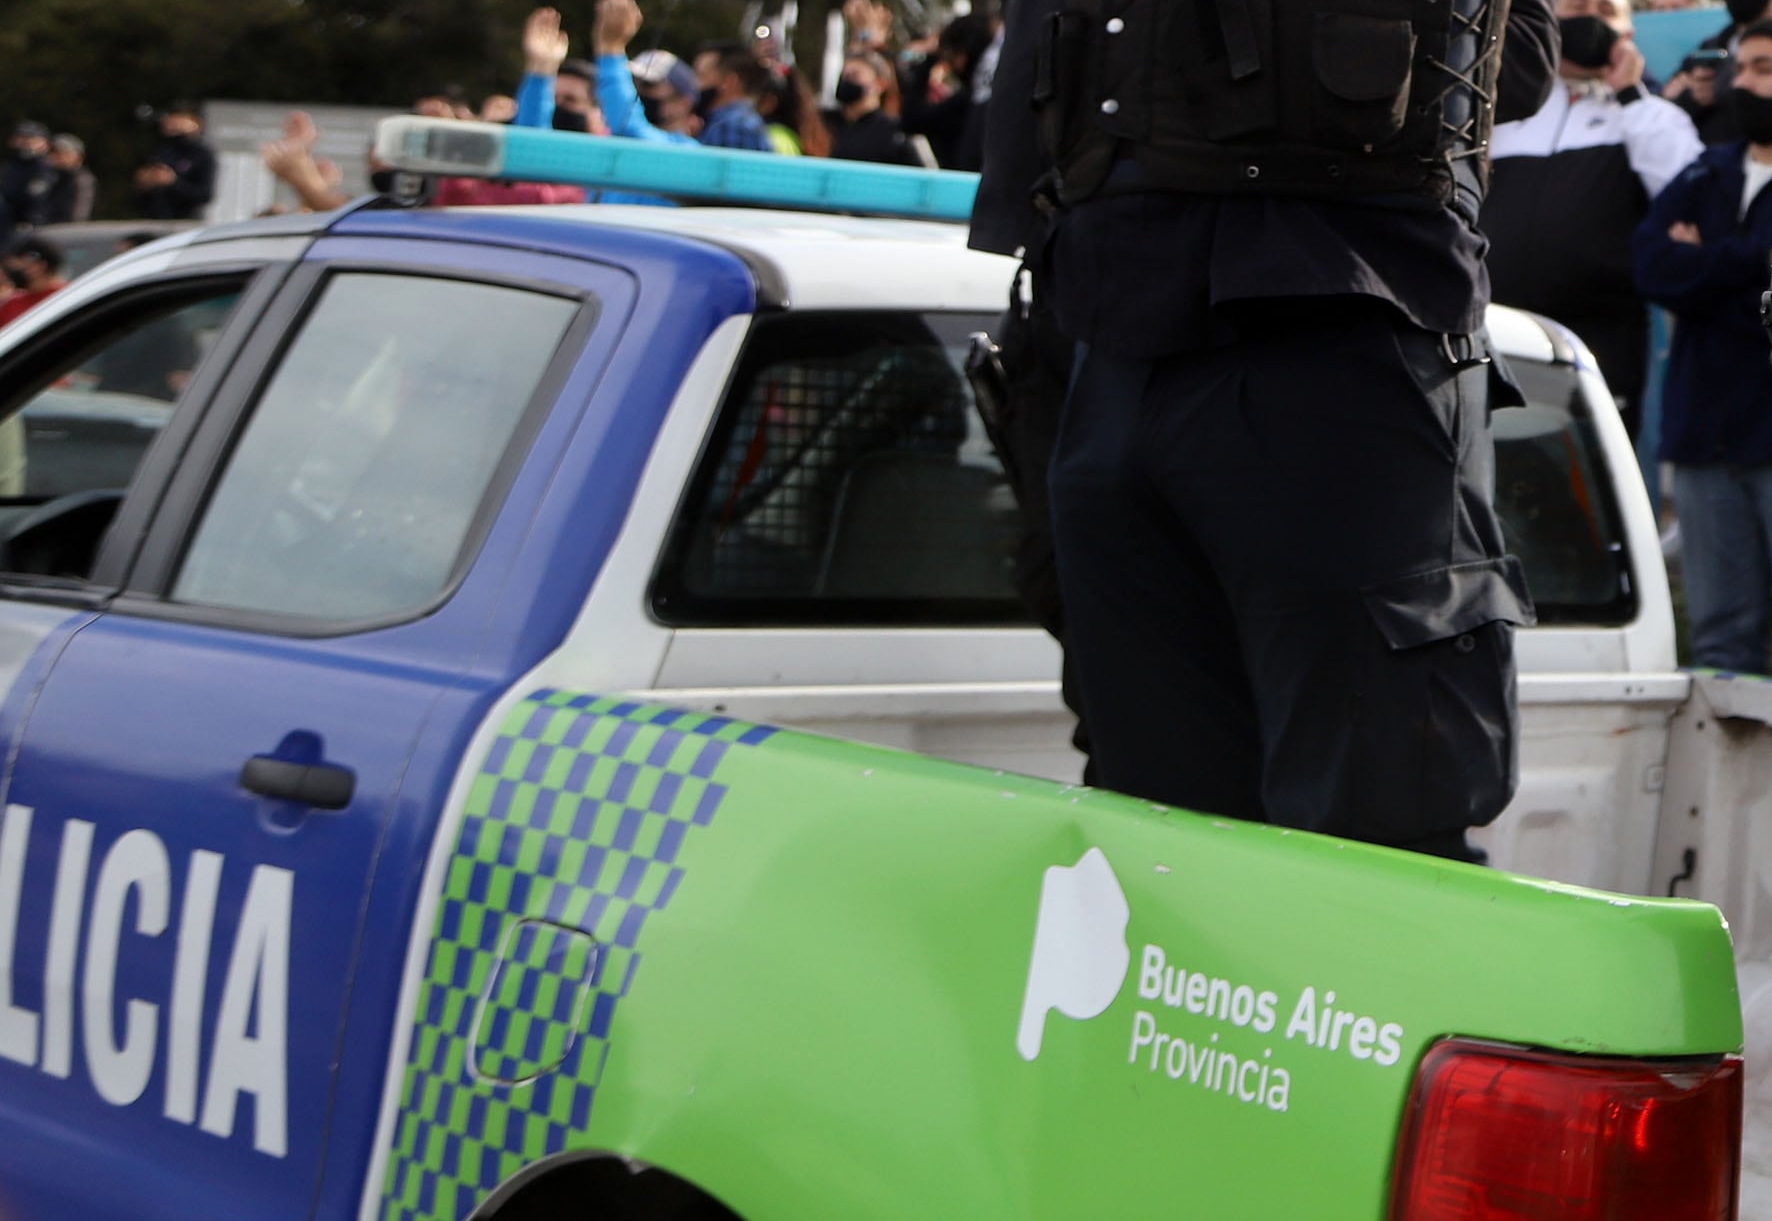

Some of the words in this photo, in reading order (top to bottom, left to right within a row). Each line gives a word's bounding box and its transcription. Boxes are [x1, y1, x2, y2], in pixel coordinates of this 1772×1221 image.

[1128, 1010, 1290, 1111] Provincia
[1137, 943, 1278, 1033] Buenos
[1285, 986, 1403, 1066] Aires
